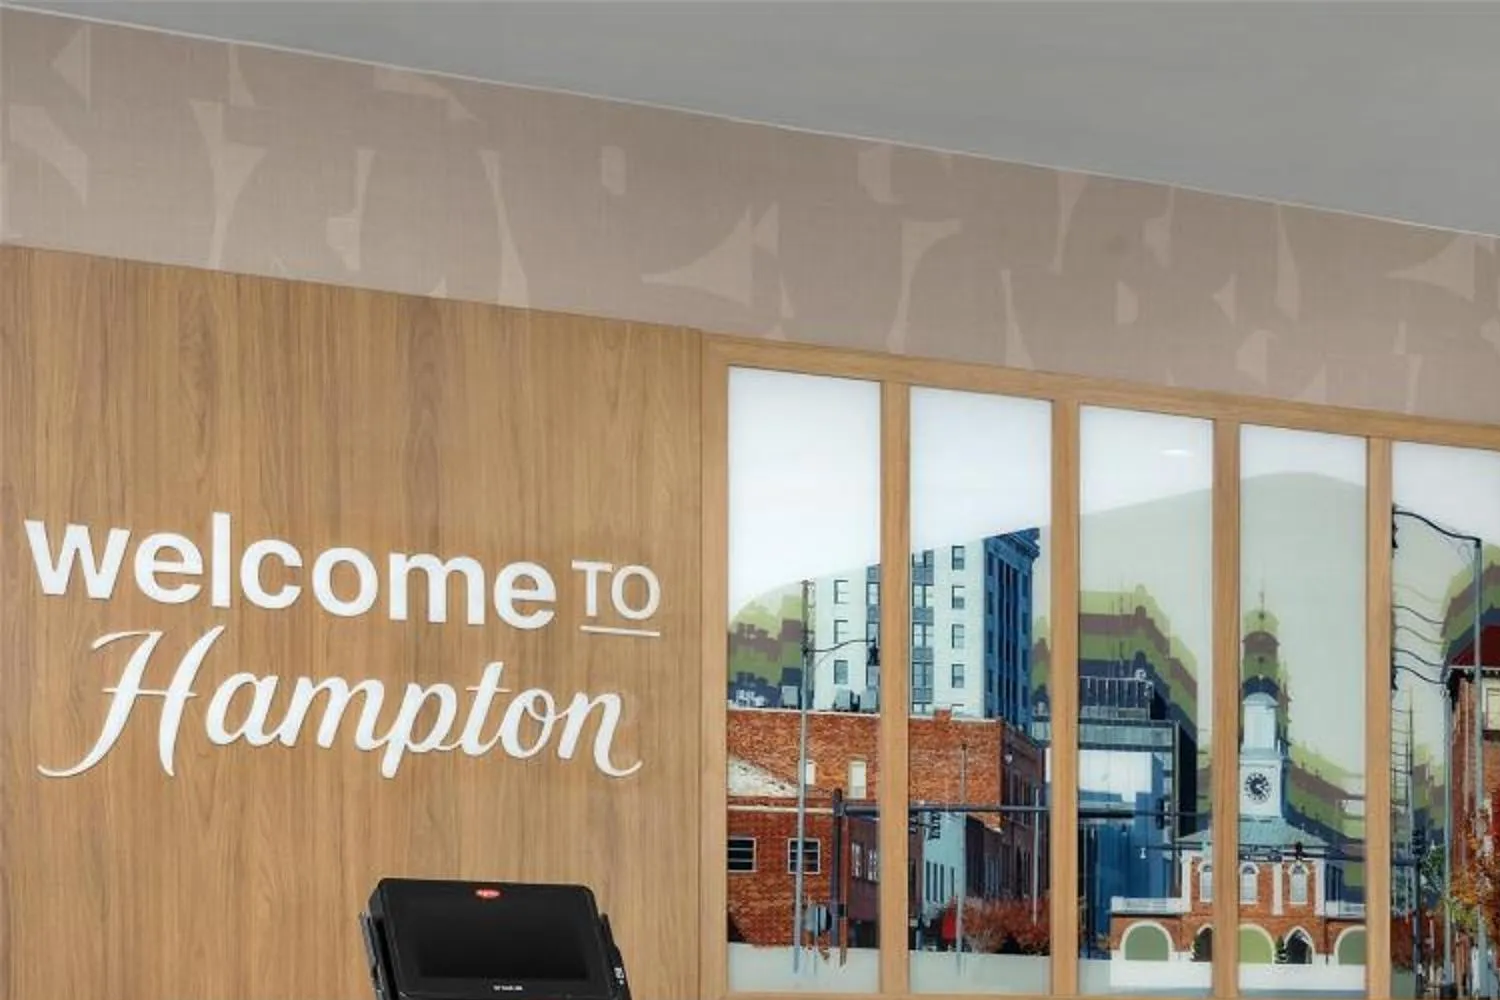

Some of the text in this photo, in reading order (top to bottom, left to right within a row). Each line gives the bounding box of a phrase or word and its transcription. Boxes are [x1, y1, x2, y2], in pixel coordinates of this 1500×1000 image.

[24, 511, 661, 629] welcome TO
[37, 625, 642, 778] Hampton
